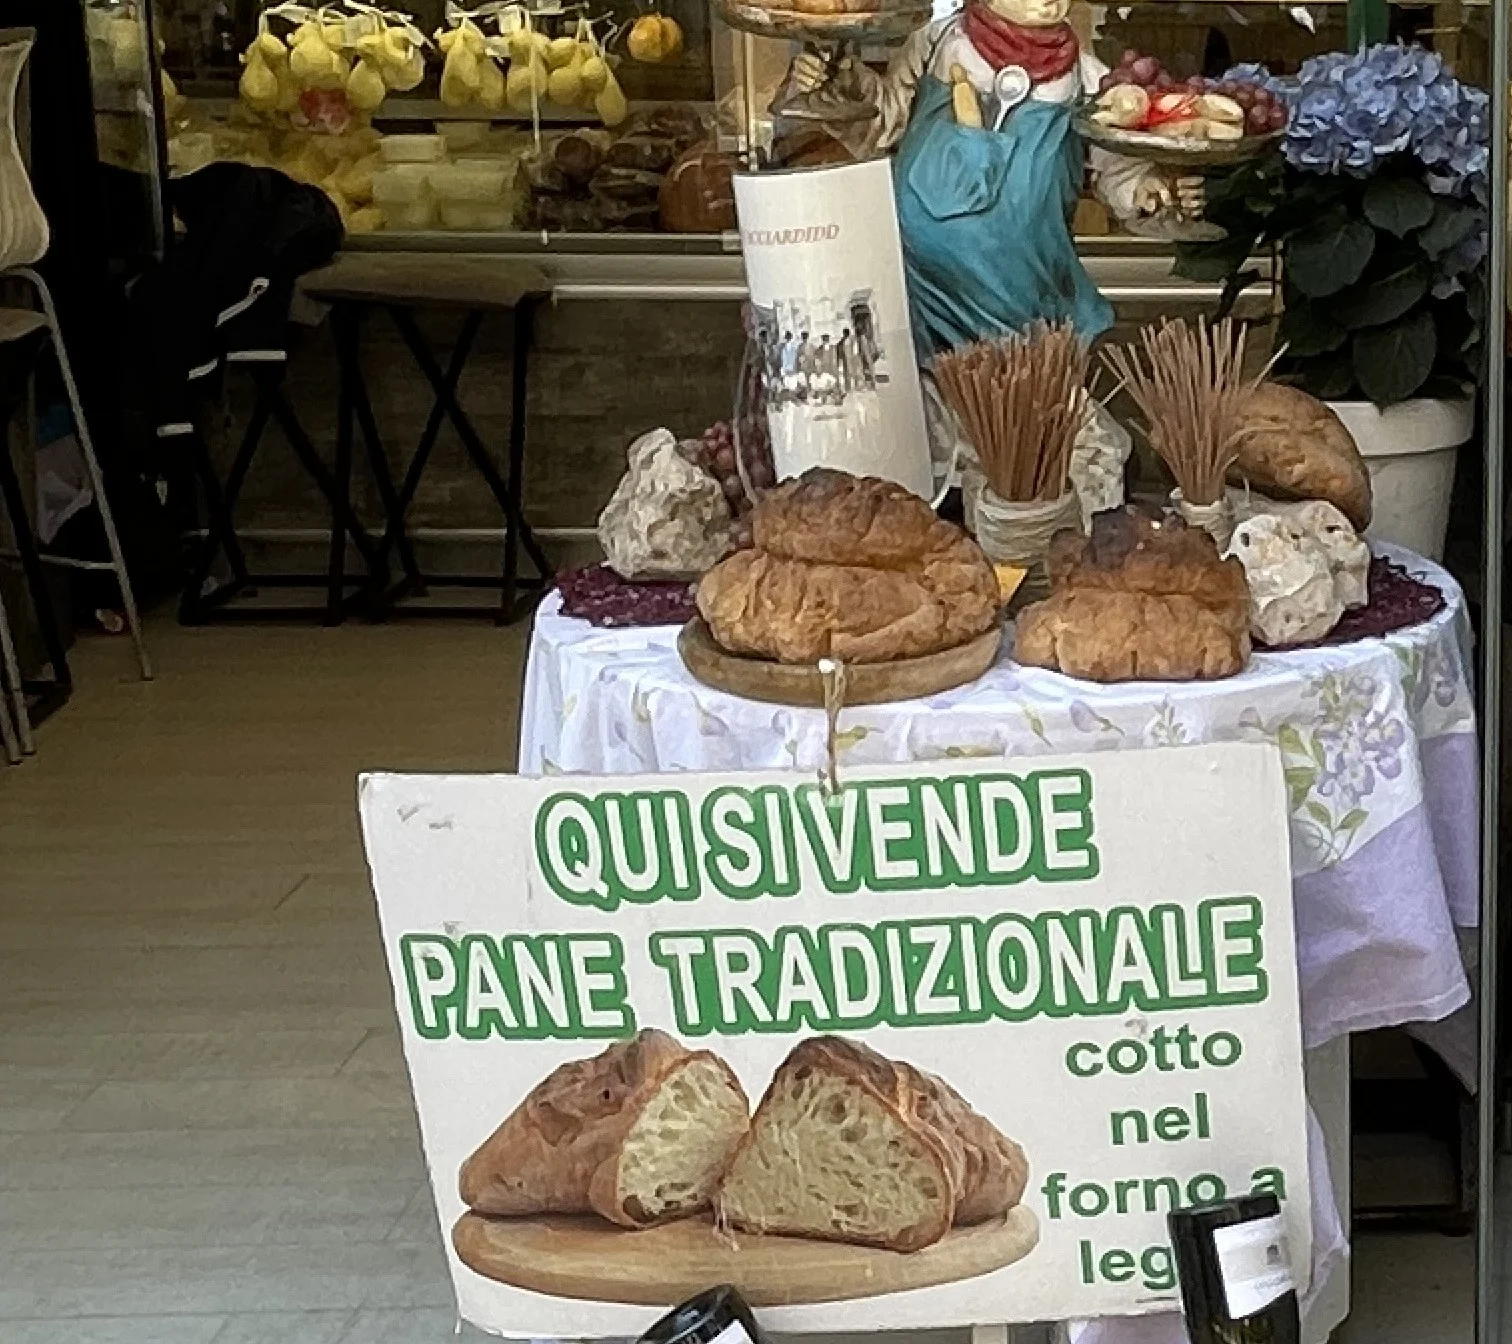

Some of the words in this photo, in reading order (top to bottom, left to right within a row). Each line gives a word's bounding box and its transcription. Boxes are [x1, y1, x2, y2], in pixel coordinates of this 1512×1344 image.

[535, 791, 701, 912] QUI
[702, 785, 802, 899] SI
[800, 768, 1101, 894] VENDE
[401, 932, 637, 1039] PANE
[650, 895, 1268, 1034] TRADIZIONALE
[1065, 1023, 1242, 1077] cotto
[1110, 1092, 1211, 1145] nel
[1040, 1172, 1226, 1219] forno
[1250, 1167, 1286, 1200] a
[1080, 1239, 1178, 1290] leg
